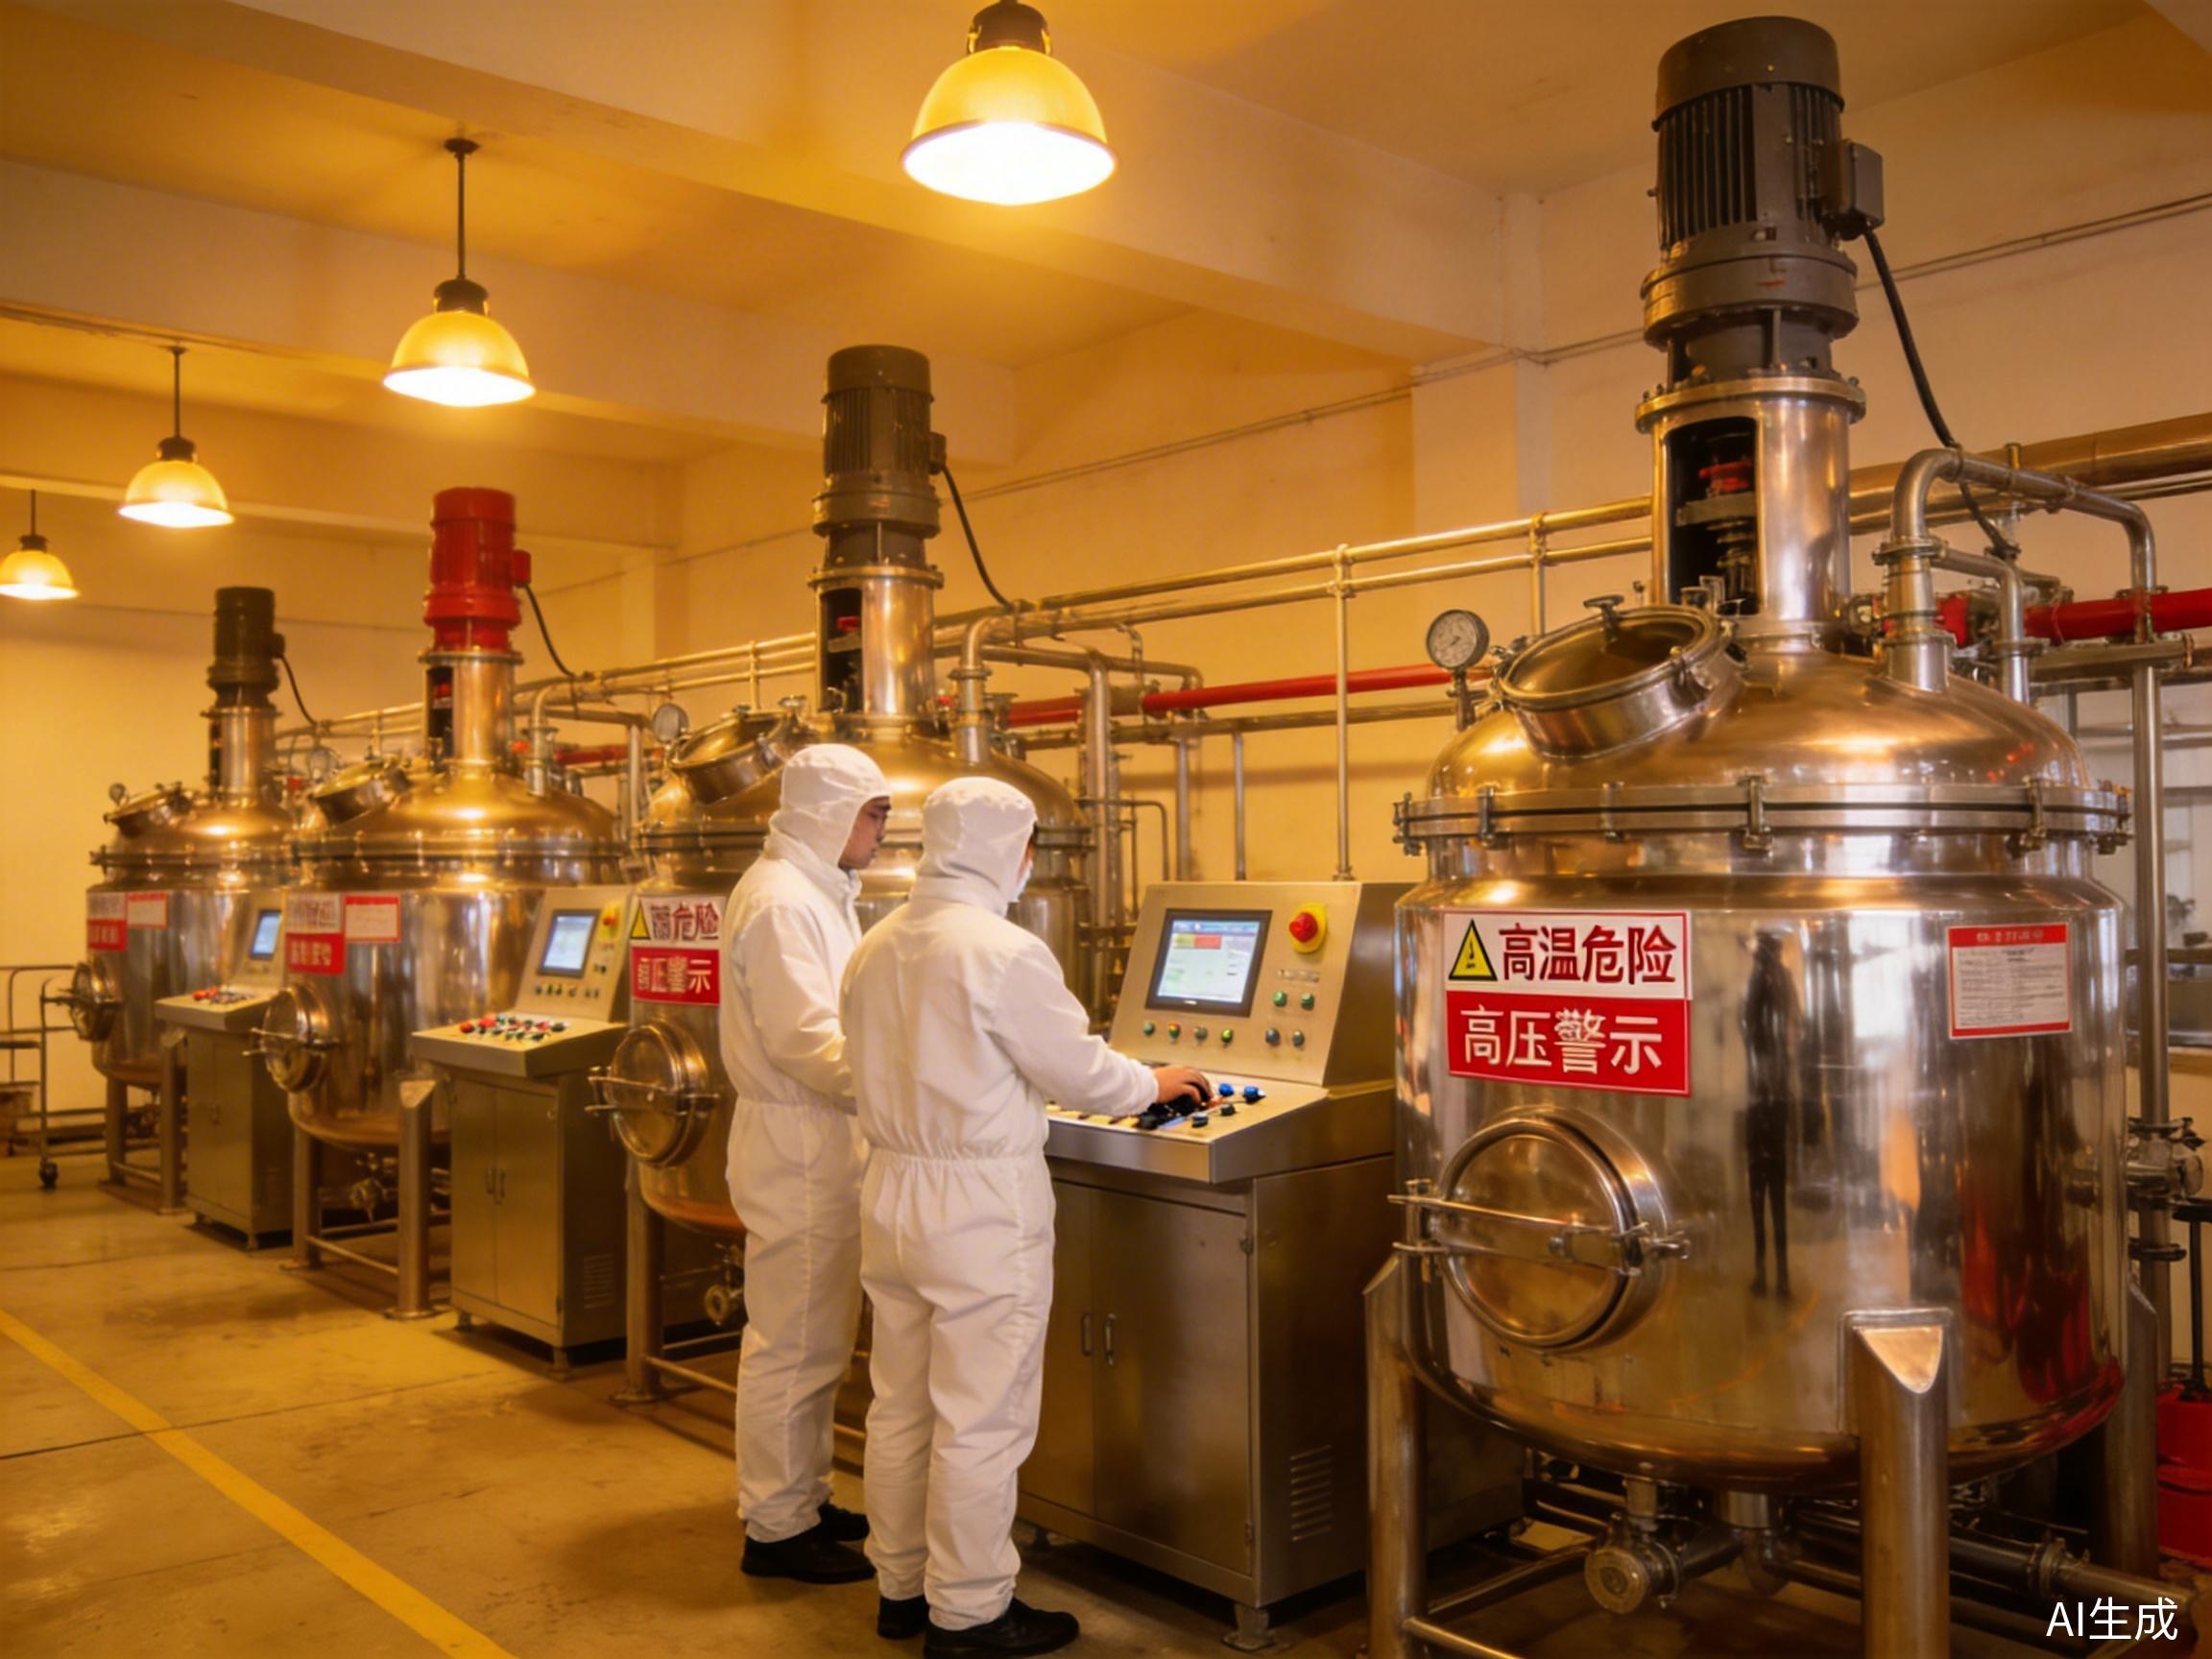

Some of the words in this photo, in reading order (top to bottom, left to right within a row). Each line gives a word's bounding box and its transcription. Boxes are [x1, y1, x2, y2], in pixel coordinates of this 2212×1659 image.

[1499, 923, 1677, 985] 高温危险
[1460, 1004, 1663, 1075] 高压警示
